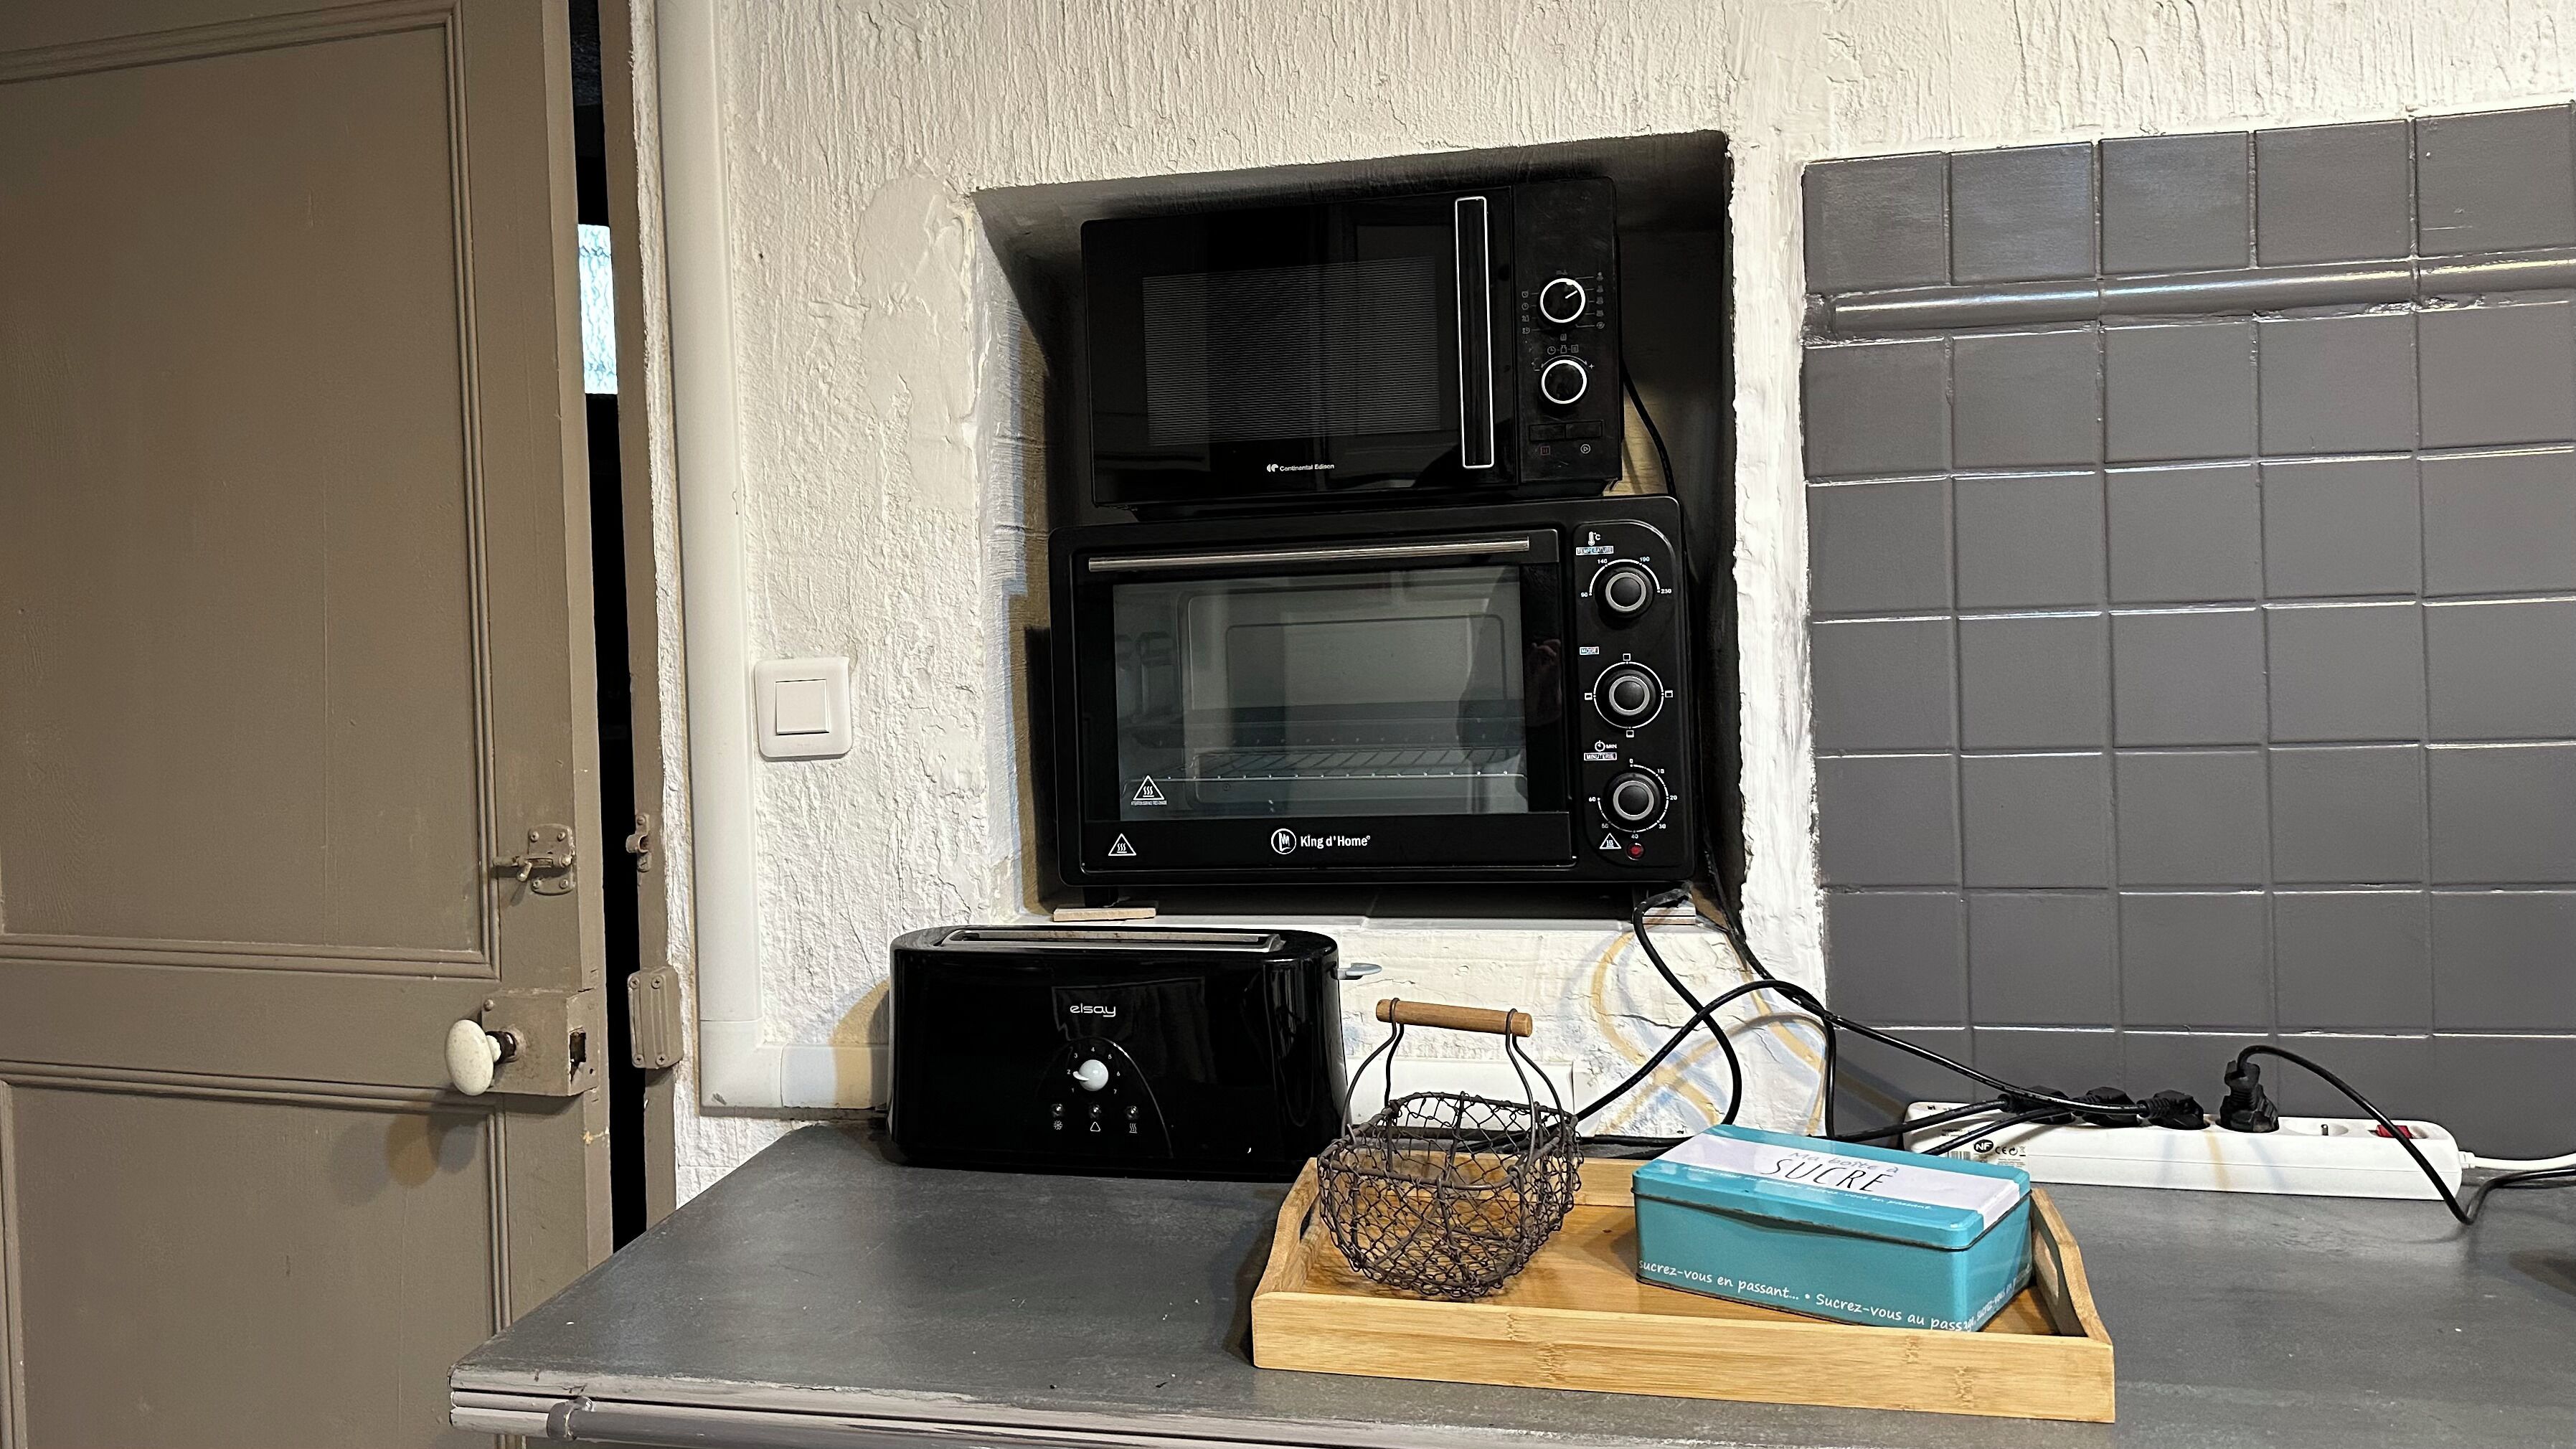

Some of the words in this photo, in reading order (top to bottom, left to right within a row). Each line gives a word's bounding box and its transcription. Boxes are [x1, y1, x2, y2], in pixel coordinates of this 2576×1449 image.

[1300, 834, 1324, 849] King
[1070, 1002, 1116, 1018] elsay
[1976, 1142, 1992, 1151] NF
[1788, 1152, 1819, 1161] Ma
[1760, 1158, 1895, 1192] SUCRE
[1638, 1260, 1713, 1283] sucrez-vous
[1717, 1275, 1734, 1288] en
[1737, 1279, 1799, 1301] passant...
[1816, 1293, 1902, 1321] Sucrez-vous
[1907, 1314, 1925, 1326] au
